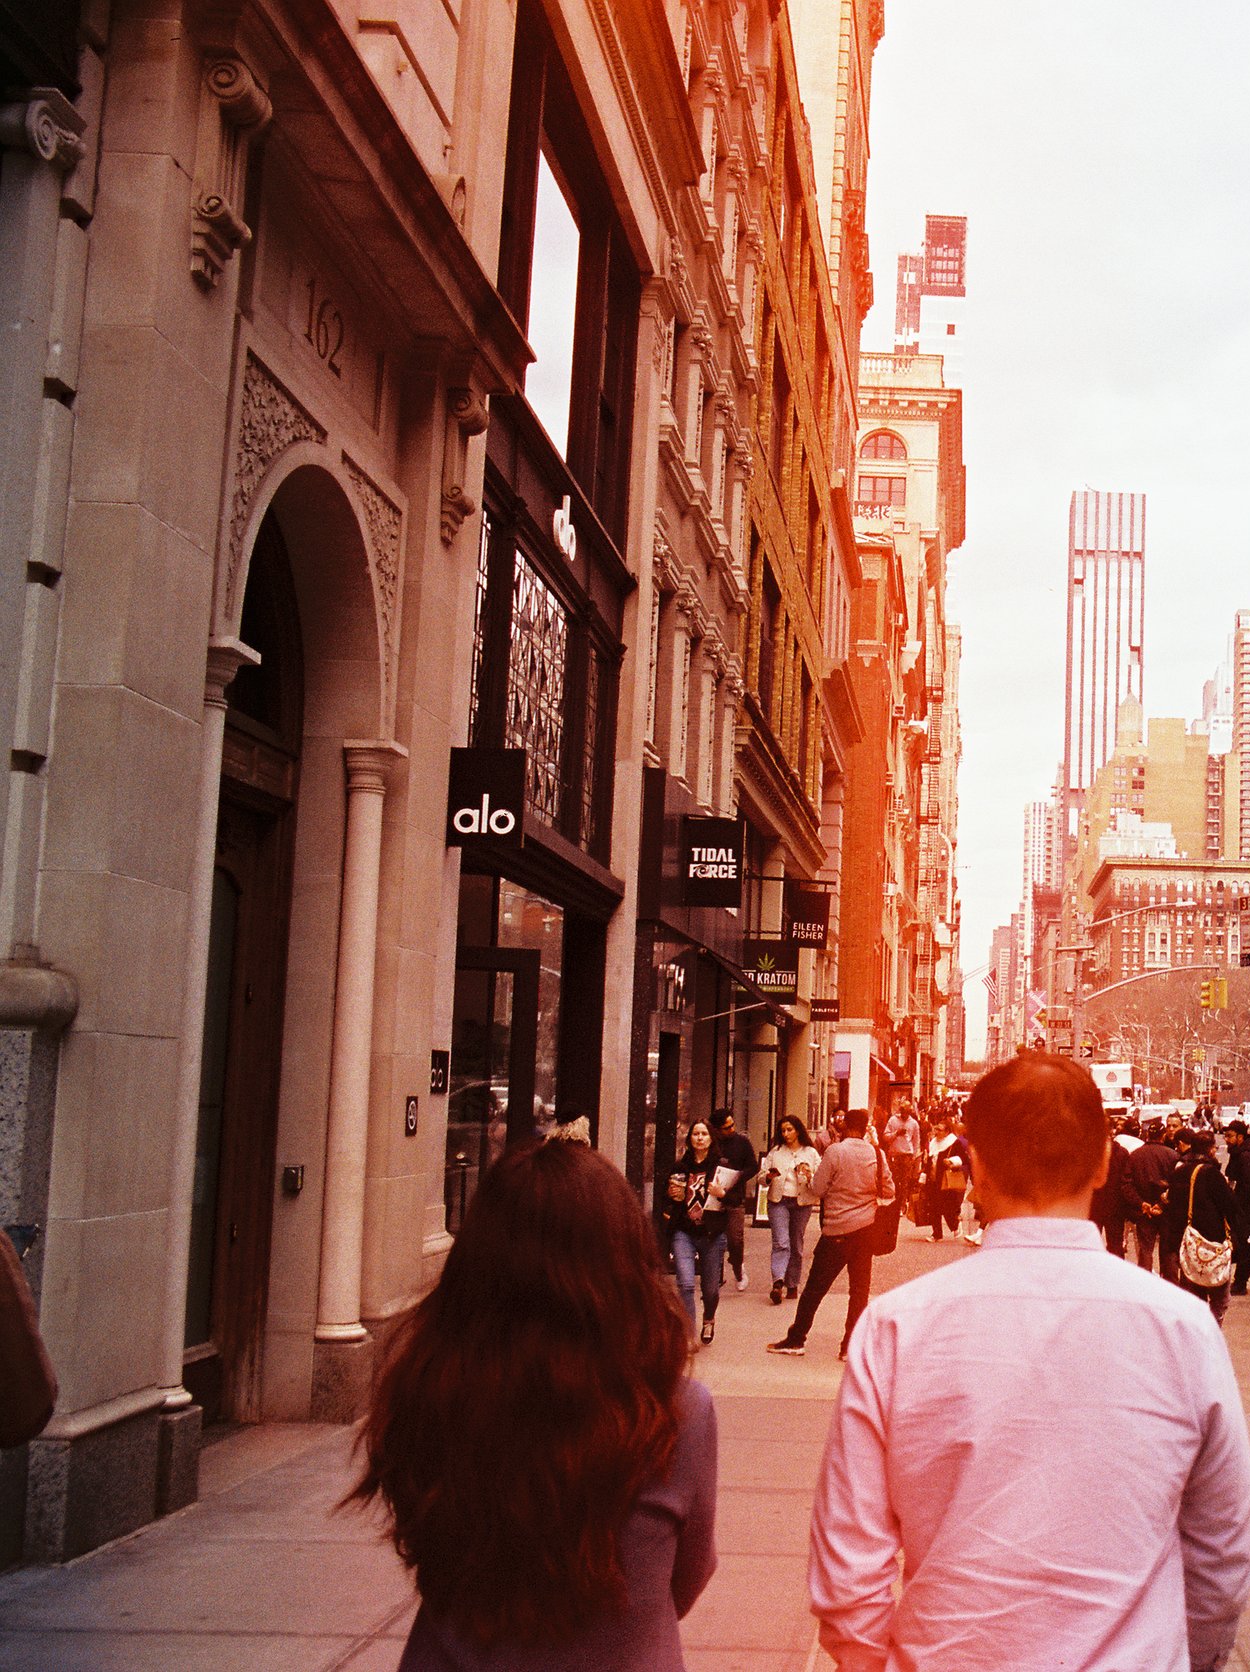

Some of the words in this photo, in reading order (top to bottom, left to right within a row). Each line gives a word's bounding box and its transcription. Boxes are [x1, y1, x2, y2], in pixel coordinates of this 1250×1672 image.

[304, 279, 344, 379] 162
[553, 495, 576, 562] alo
[453, 793, 516, 835] alo
[691, 847, 737, 863] TIDAL
[688, 863, 738, 879] FORCE
[792, 922, 824, 931] EILEEN
[792, 930, 824, 940] FISHER
[757, 973, 796, 985] KRATOM
